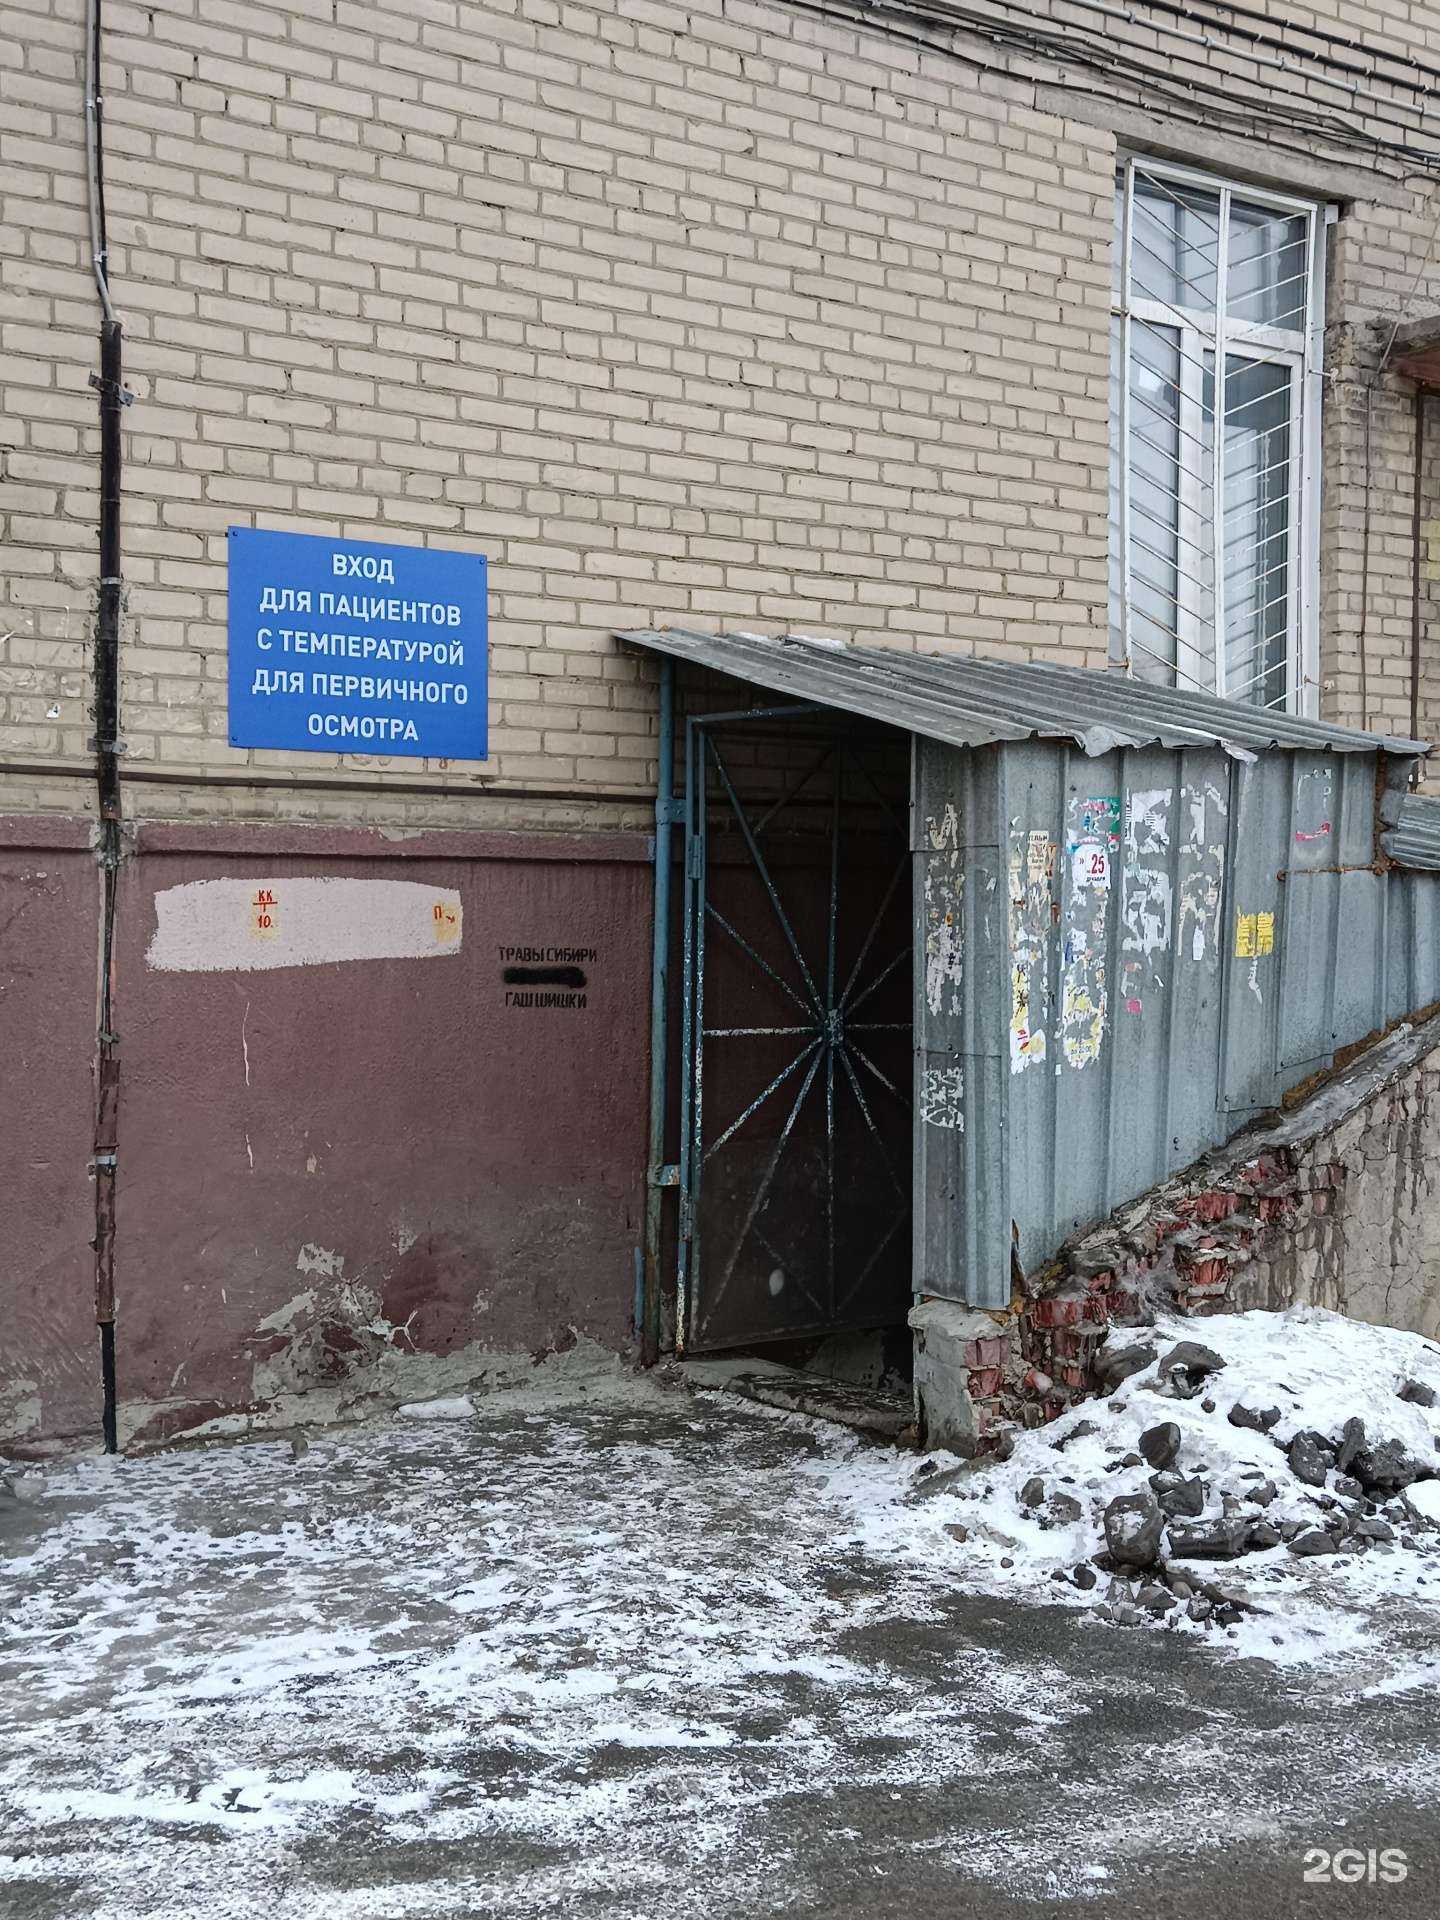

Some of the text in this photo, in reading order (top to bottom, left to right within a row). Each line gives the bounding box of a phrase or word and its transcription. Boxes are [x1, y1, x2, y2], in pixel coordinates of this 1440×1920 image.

[332, 553, 395, 585] ВХОД
[259, 587, 462, 626] ДЛЯ ПАЦИЕНТОВ
[257, 628, 464, 666] С ТЕМПЕРАТУРОЙ
[252, 669, 468, 705] ДЛЯ ПЕРВИЧНОГО
[307, 713, 419, 741] ОСМОТРА
[1091, 853, 1105, 874] 25
[499, 946, 597, 962] ТРАВЫ СИБИРИ
[535, 992, 587, 1009] ШИШКИ
